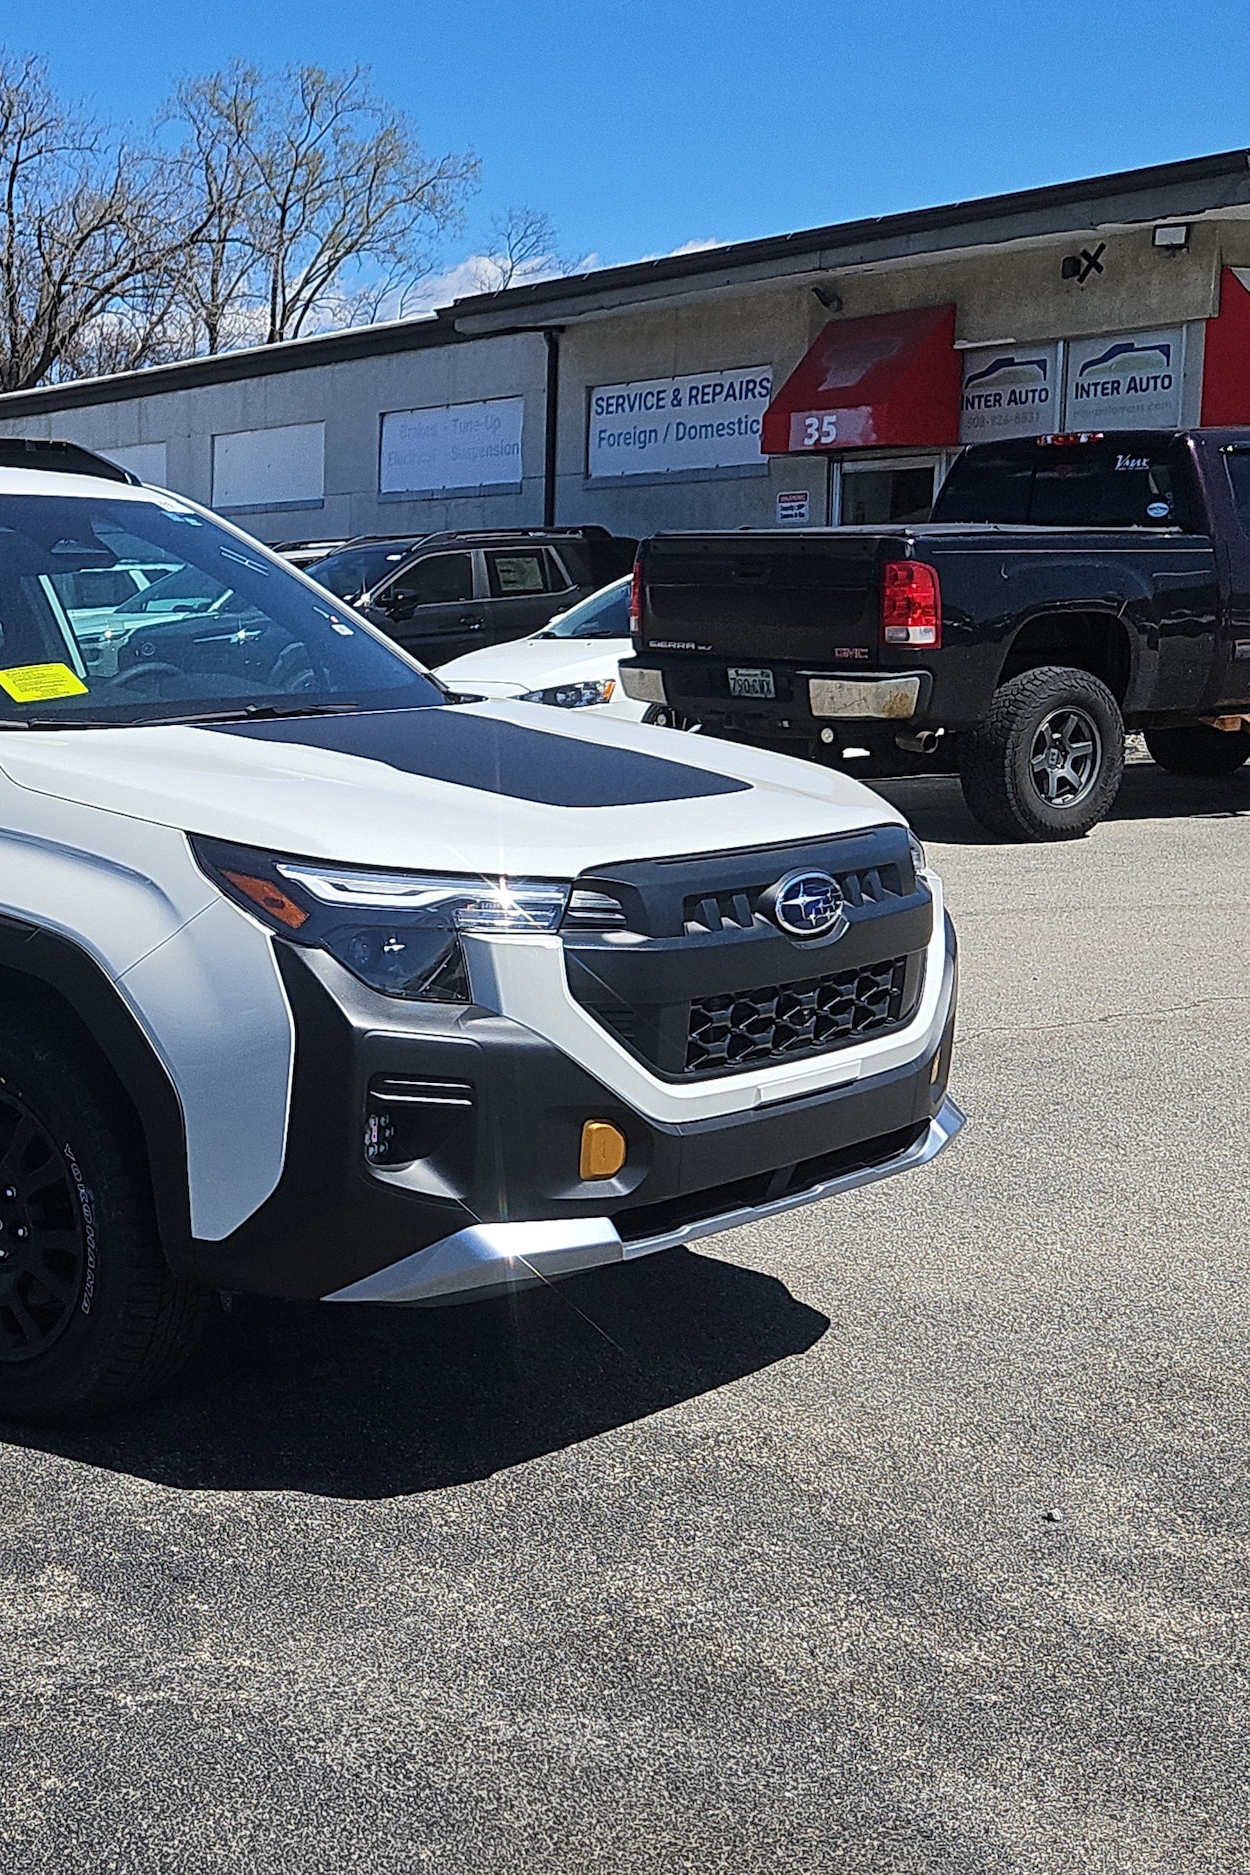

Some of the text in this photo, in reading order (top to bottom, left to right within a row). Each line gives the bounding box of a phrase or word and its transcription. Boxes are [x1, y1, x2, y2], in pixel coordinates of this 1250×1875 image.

[594, 377, 771, 417] SERVICE & REPAIRS
[1006, 387, 1049, 407] AUTO
[1074, 374, 1173, 400] INTER AUTO
[598, 425, 658, 450] Foreign
[675, 414, 761, 441] Domestic
[803, 415, 837, 445] 35
[648, 640, 696, 650] SIERRA
[834, 647, 869, 659] GMC
[63, 1143, 98, 1315] YOKOHAMA
